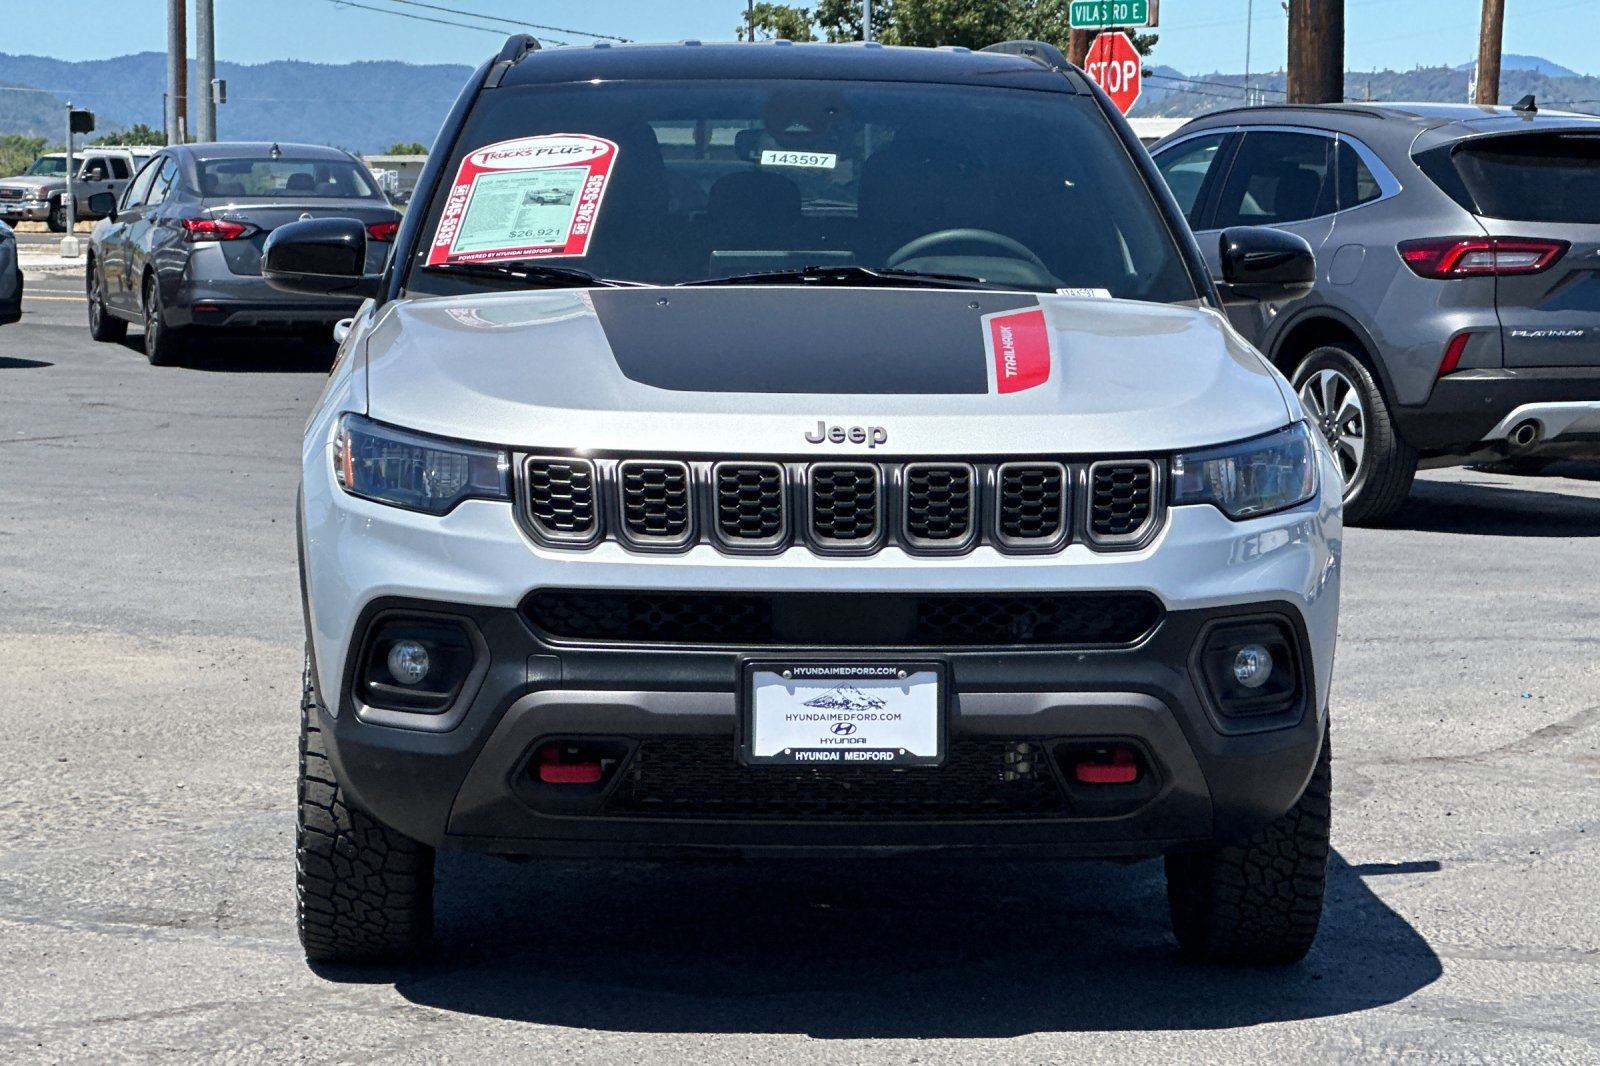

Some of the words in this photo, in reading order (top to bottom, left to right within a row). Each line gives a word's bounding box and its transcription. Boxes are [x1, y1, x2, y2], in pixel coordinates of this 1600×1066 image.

[1075, 5, 1108, 21] VILAS
[1113, 4, 1128, 20] RD
[1087, 60, 1137, 92] STOP
[535, 146, 585, 156] PLUS
[769, 153, 829, 166] 143597
[575, 174, 605, 223] 245-5335
[435, 196, 466, 247] 245-5335
[458, 253, 487, 261] POWERED
[496, 250, 523, 258] HYUNDAI
[523, 247, 553, 255] MEDFORD
[1000, 326, 1018, 378] TRAILHAWK
[804, 420, 888, 449] Jeep
[793, 667, 897, 676] HYUNDAIMEDFORD.COM
[785, 713, 902, 722] HYUNDAIMEDFORD.COM
[820, 737, 867, 745] HYUNDAI
[795, 751, 840, 761] HYUNDAI
[844, 751, 894, 761] MEDFORD
